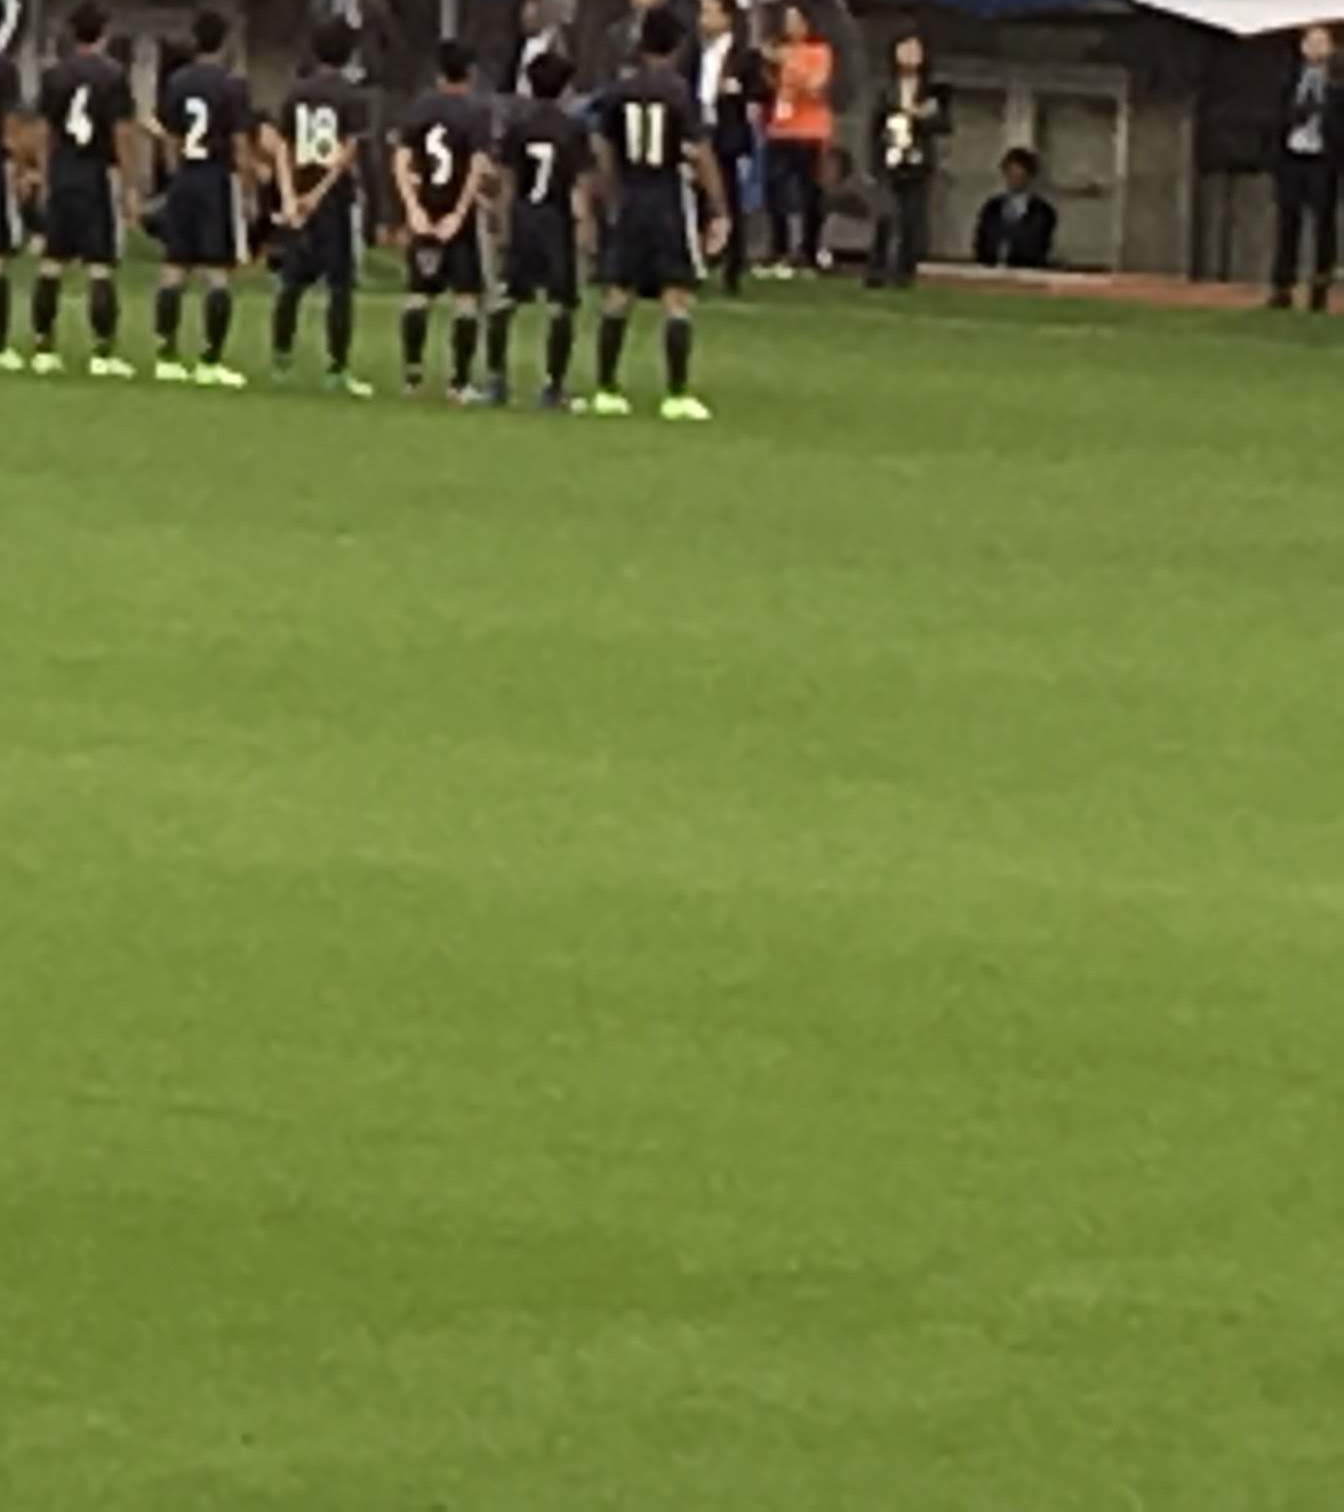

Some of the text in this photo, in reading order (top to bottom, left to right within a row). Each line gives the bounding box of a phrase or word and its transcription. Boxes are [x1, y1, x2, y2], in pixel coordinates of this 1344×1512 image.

[182, 96, 210, 159] 2
[294, 102, 341, 165] 18
[424, 124, 453, 186] 5
[624, 100, 665, 166] 11
[526, 141, 556, 205] 7
